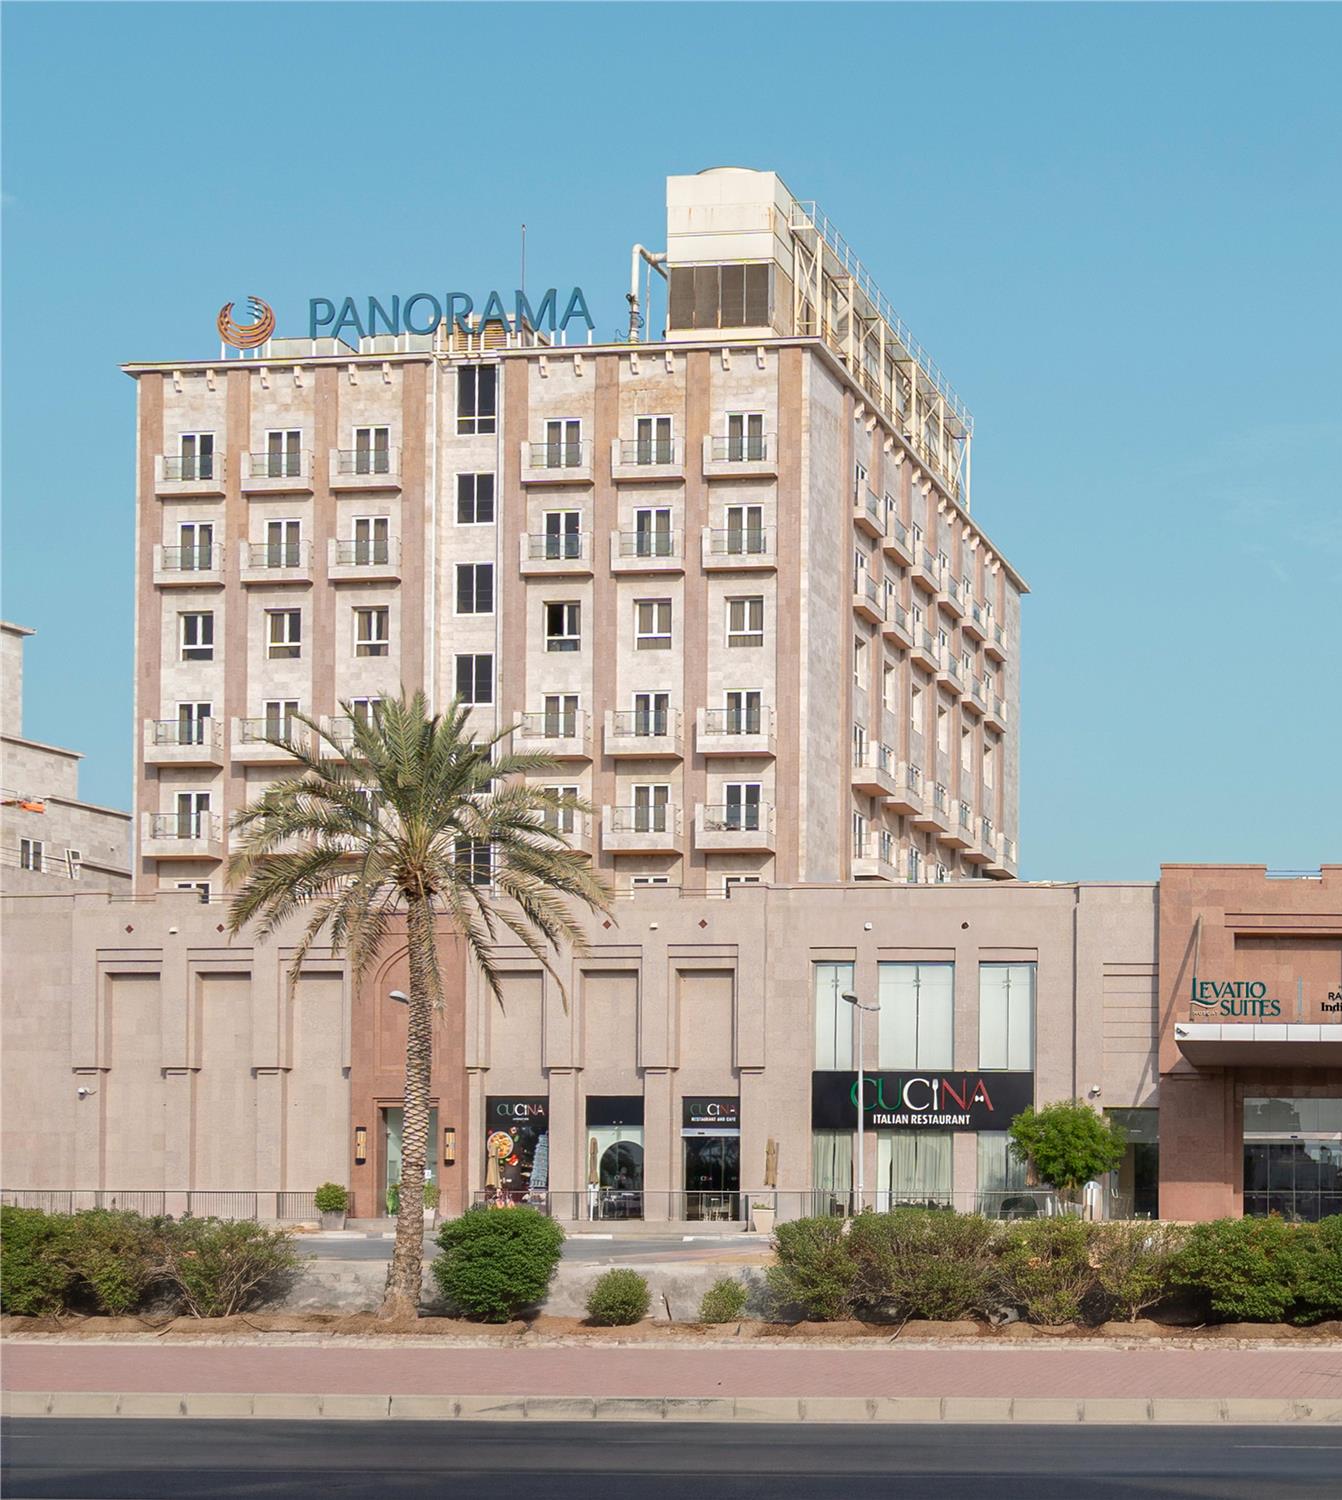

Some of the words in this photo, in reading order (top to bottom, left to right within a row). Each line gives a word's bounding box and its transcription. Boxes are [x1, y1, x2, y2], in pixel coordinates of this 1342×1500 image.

[309, 286, 595, 339] PANORAMA
[1190, 976, 1266, 1006] LEVATIO
[1220, 999, 1280, 1016] SUITES
[850, 1077, 994, 1111] CUCINA
[496, 1103, 545, 1116] CUCINA
[689, 1103, 737, 1116] CUCINA
[873, 1114, 909, 1125] ITALIAN
[911, 1114, 971, 1126] RESTAURANT
